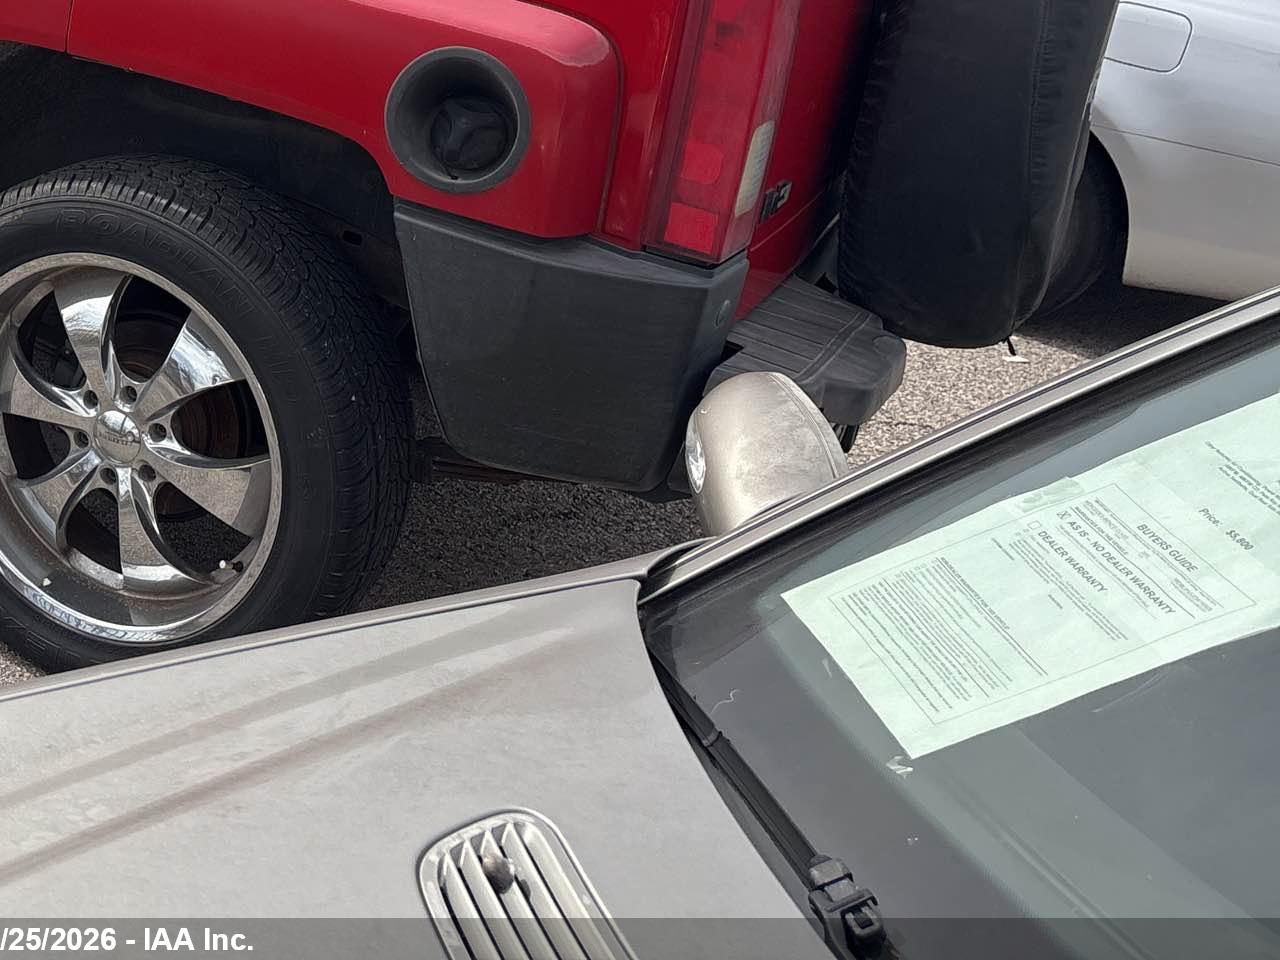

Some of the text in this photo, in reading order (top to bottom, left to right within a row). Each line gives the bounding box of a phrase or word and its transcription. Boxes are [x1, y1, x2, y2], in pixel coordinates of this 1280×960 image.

[1197, 507, 1225, 526] Price:
[1035, 530, 1070, 557] DEALER
[1062, 555, 1109, 593] WARRANTY
[1064, 519, 1083, 531] AS
[1075, 529, 1090, 538] IS
[1088, 540, 1107, 552] NO
[1099, 551, 1134, 577] DEALER
[1127, 575, 1177, 615] WARRANTY
[1135, 523, 1199, 572] BUYERS GUIDE
